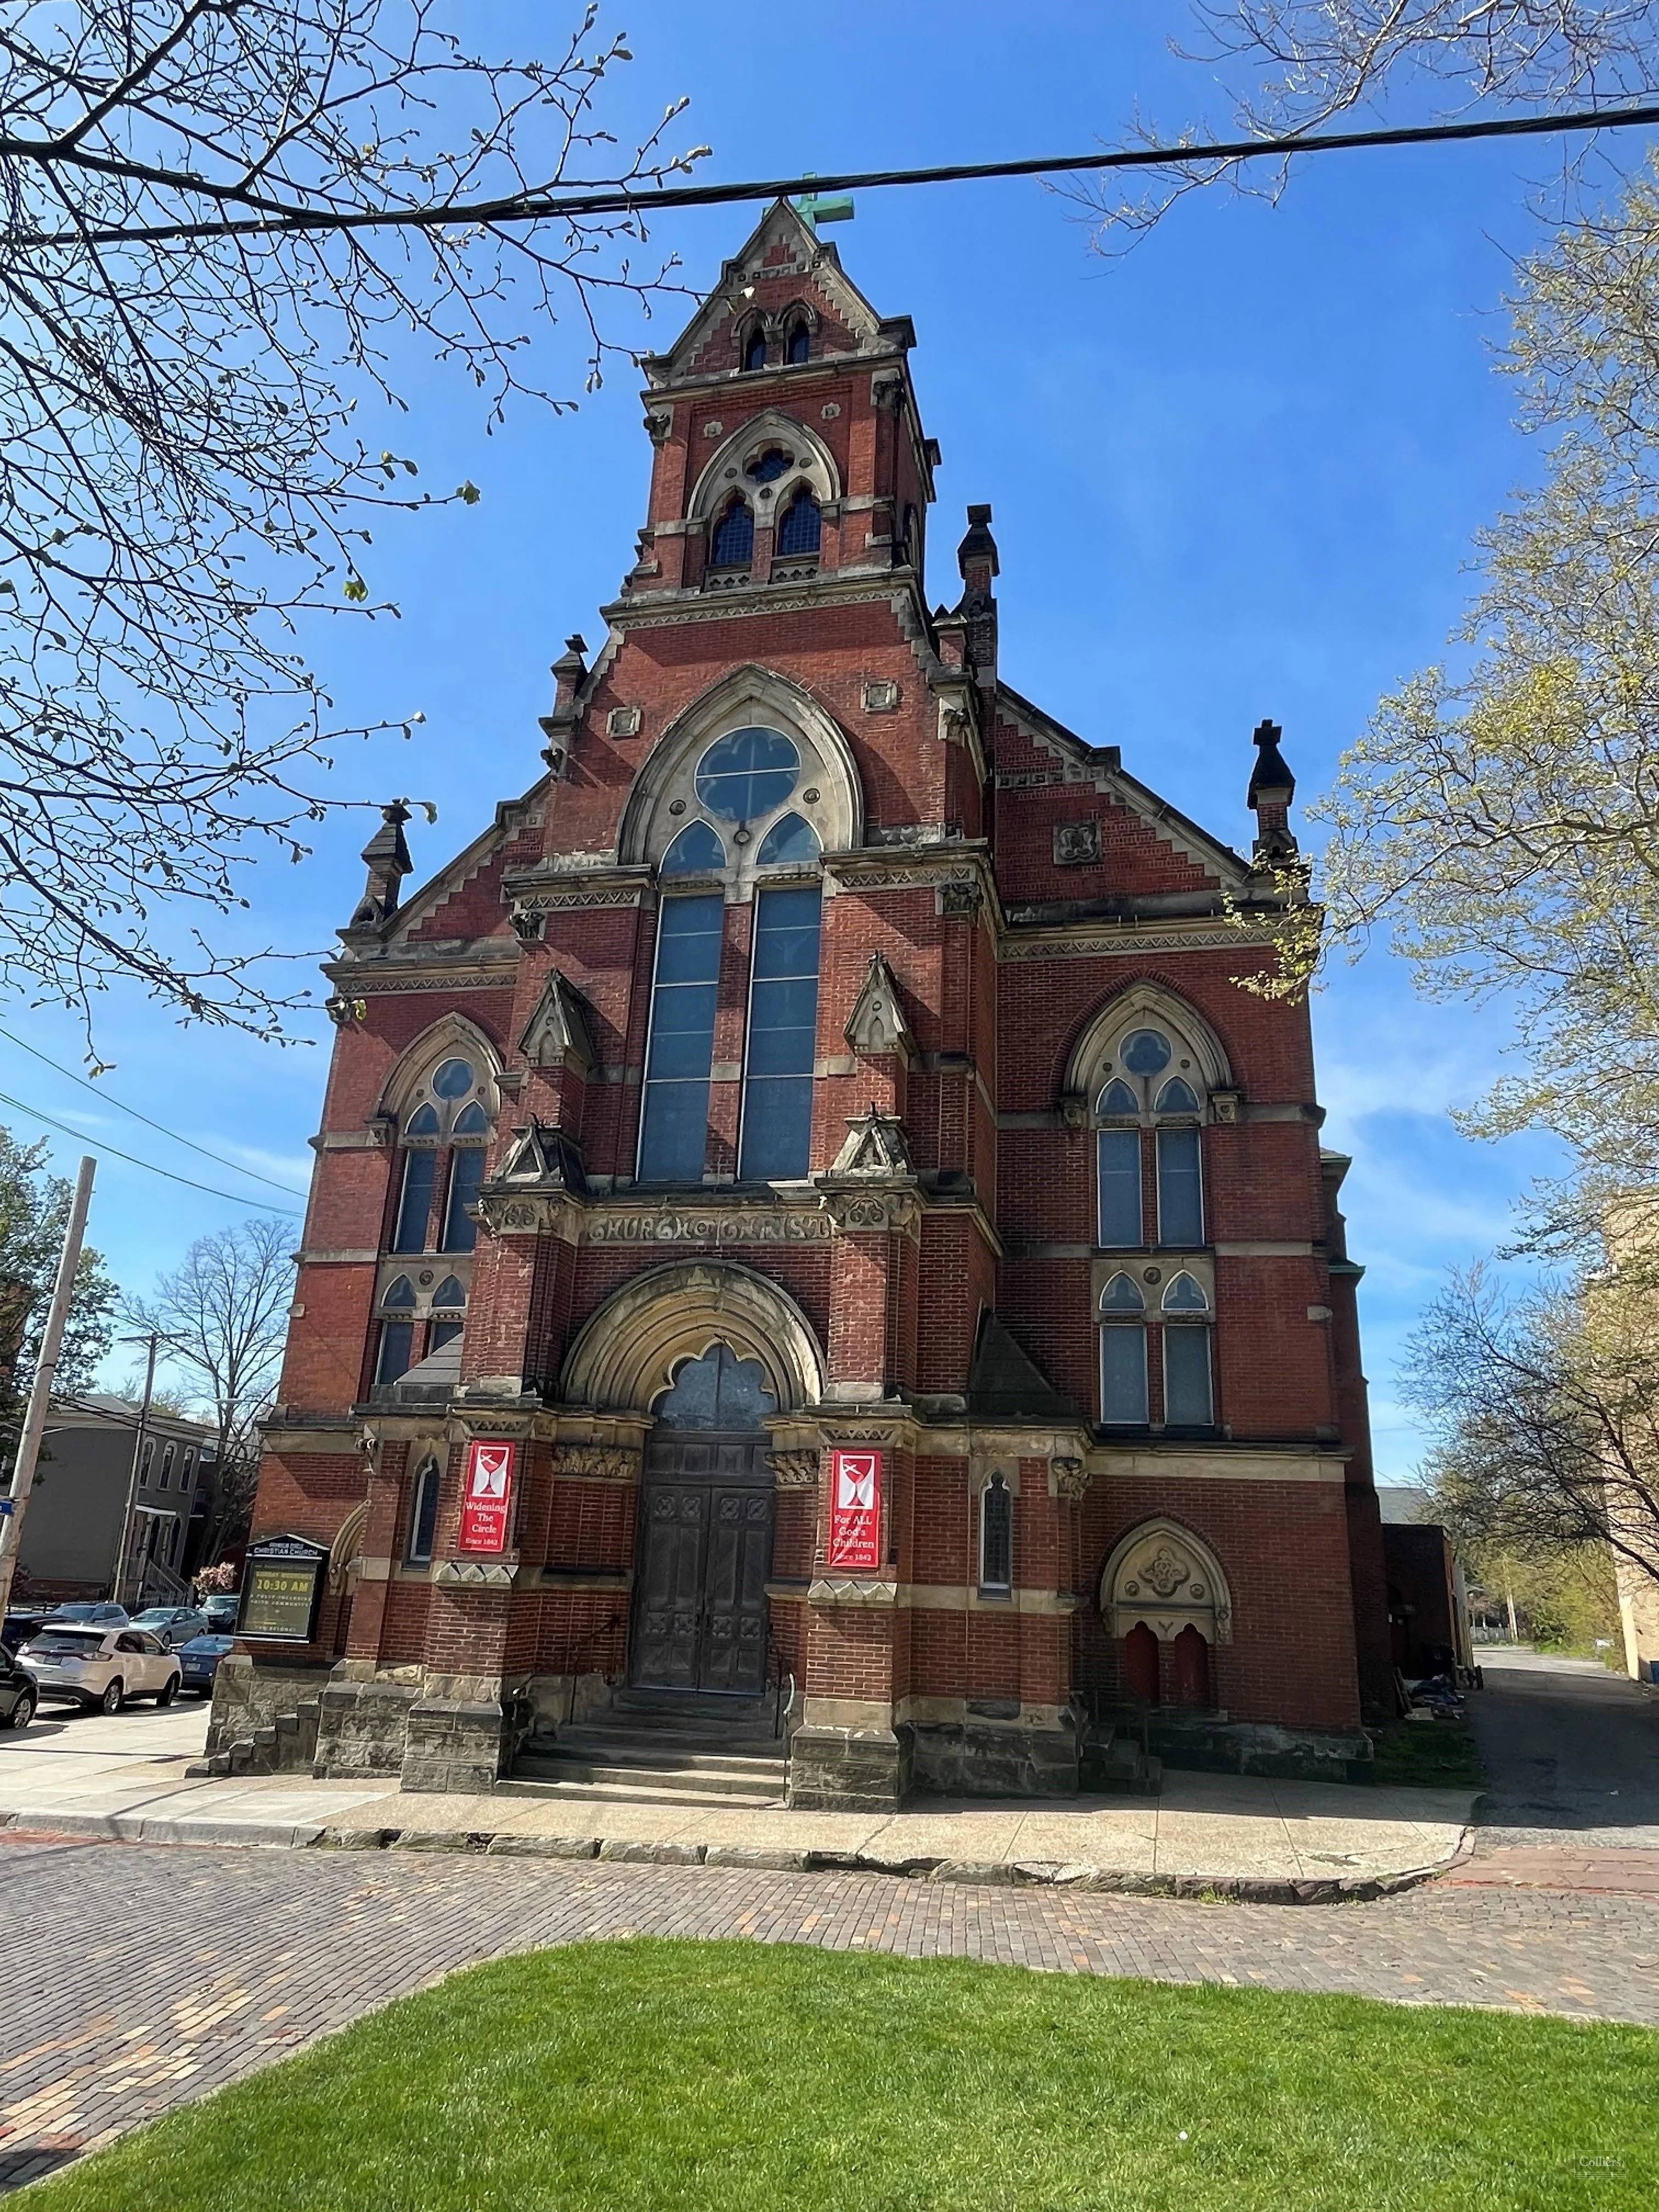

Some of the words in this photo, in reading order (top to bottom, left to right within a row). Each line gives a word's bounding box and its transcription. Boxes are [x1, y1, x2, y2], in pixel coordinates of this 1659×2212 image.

[466, 1501, 507, 1514] Widening
[477, 1513, 494, 1522] The
[834, 1514, 850, 1524] For
[853, 1515, 872, 1525] ALL
[471, 1524, 497, 1534] Circle
[838, 1526, 866, 1536] God's
[833, 1538, 874, 1549] Children
[256, 1579, 287, 1591] 10:30
[291, 1581, 308, 1592] AM
